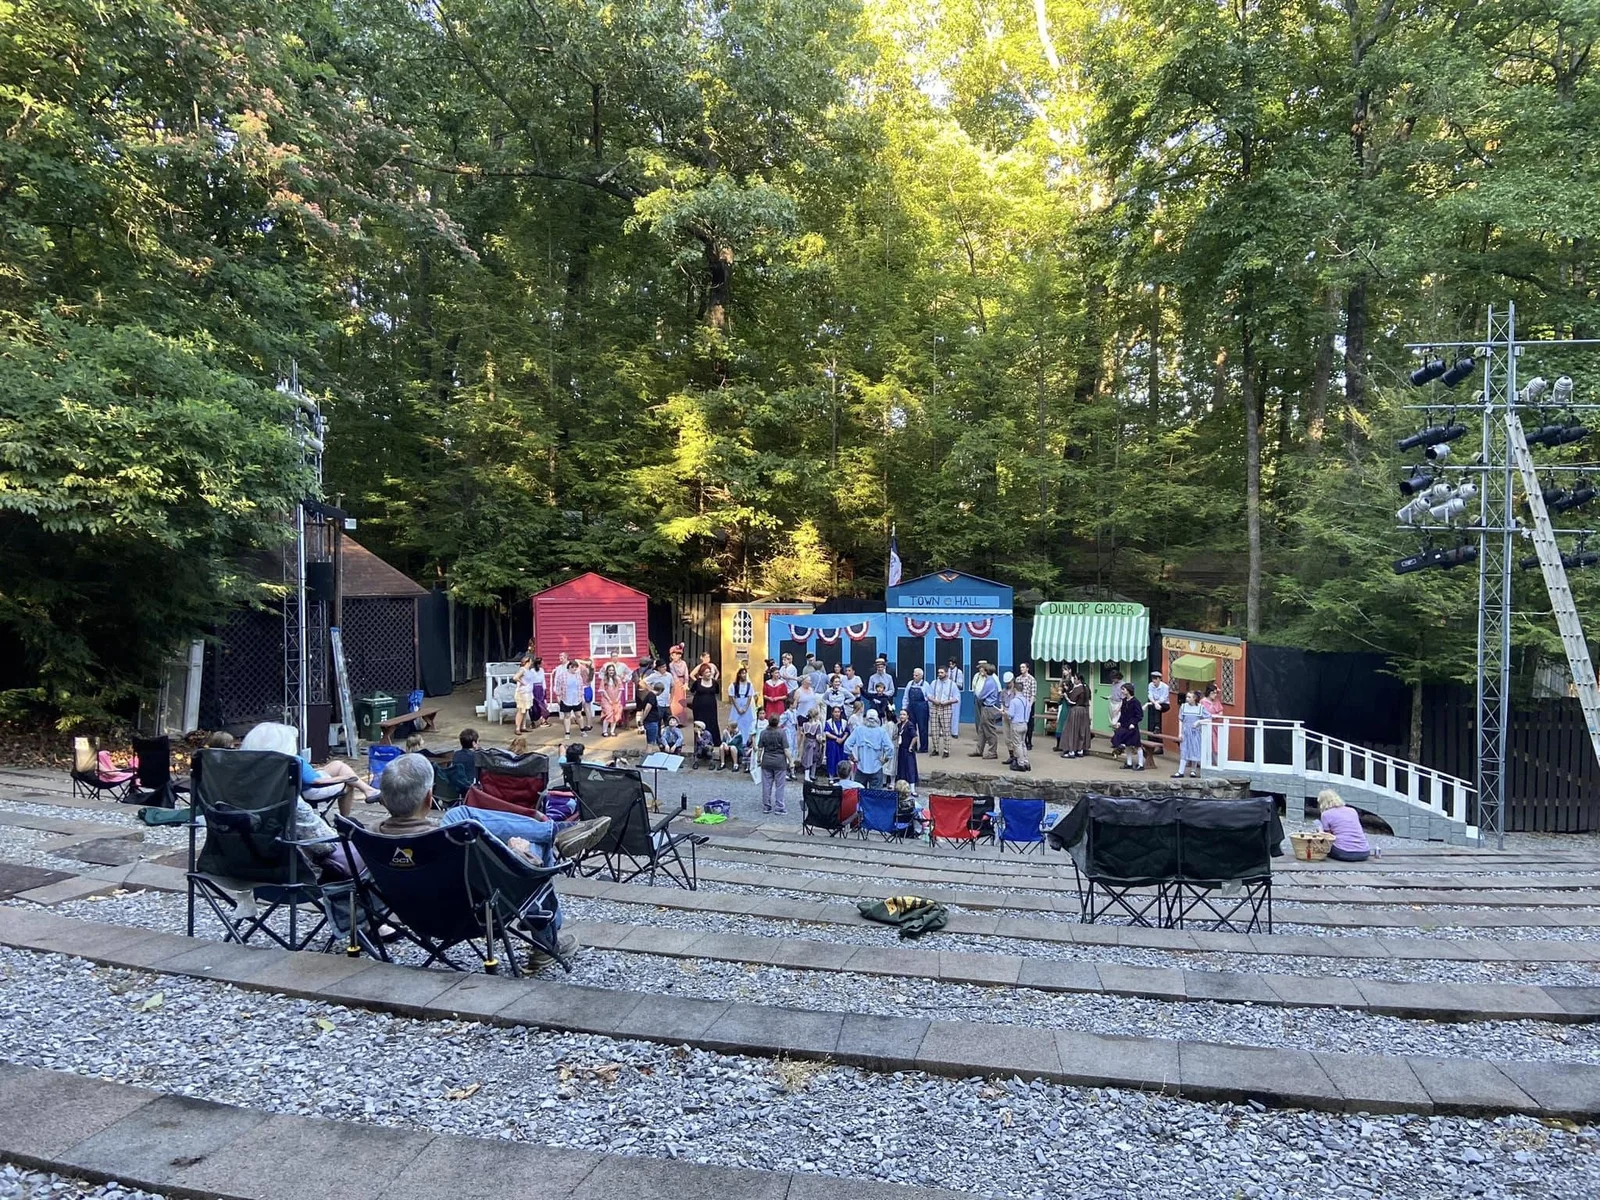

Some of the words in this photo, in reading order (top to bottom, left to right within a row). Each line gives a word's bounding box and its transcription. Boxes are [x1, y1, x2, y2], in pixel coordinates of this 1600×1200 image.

[910, 596, 940, 606] TOWN
[955, 597, 979, 606] HALL
[1049, 603, 1090, 615] DUNLOP
[1094, 603, 1134, 615] GROCER
